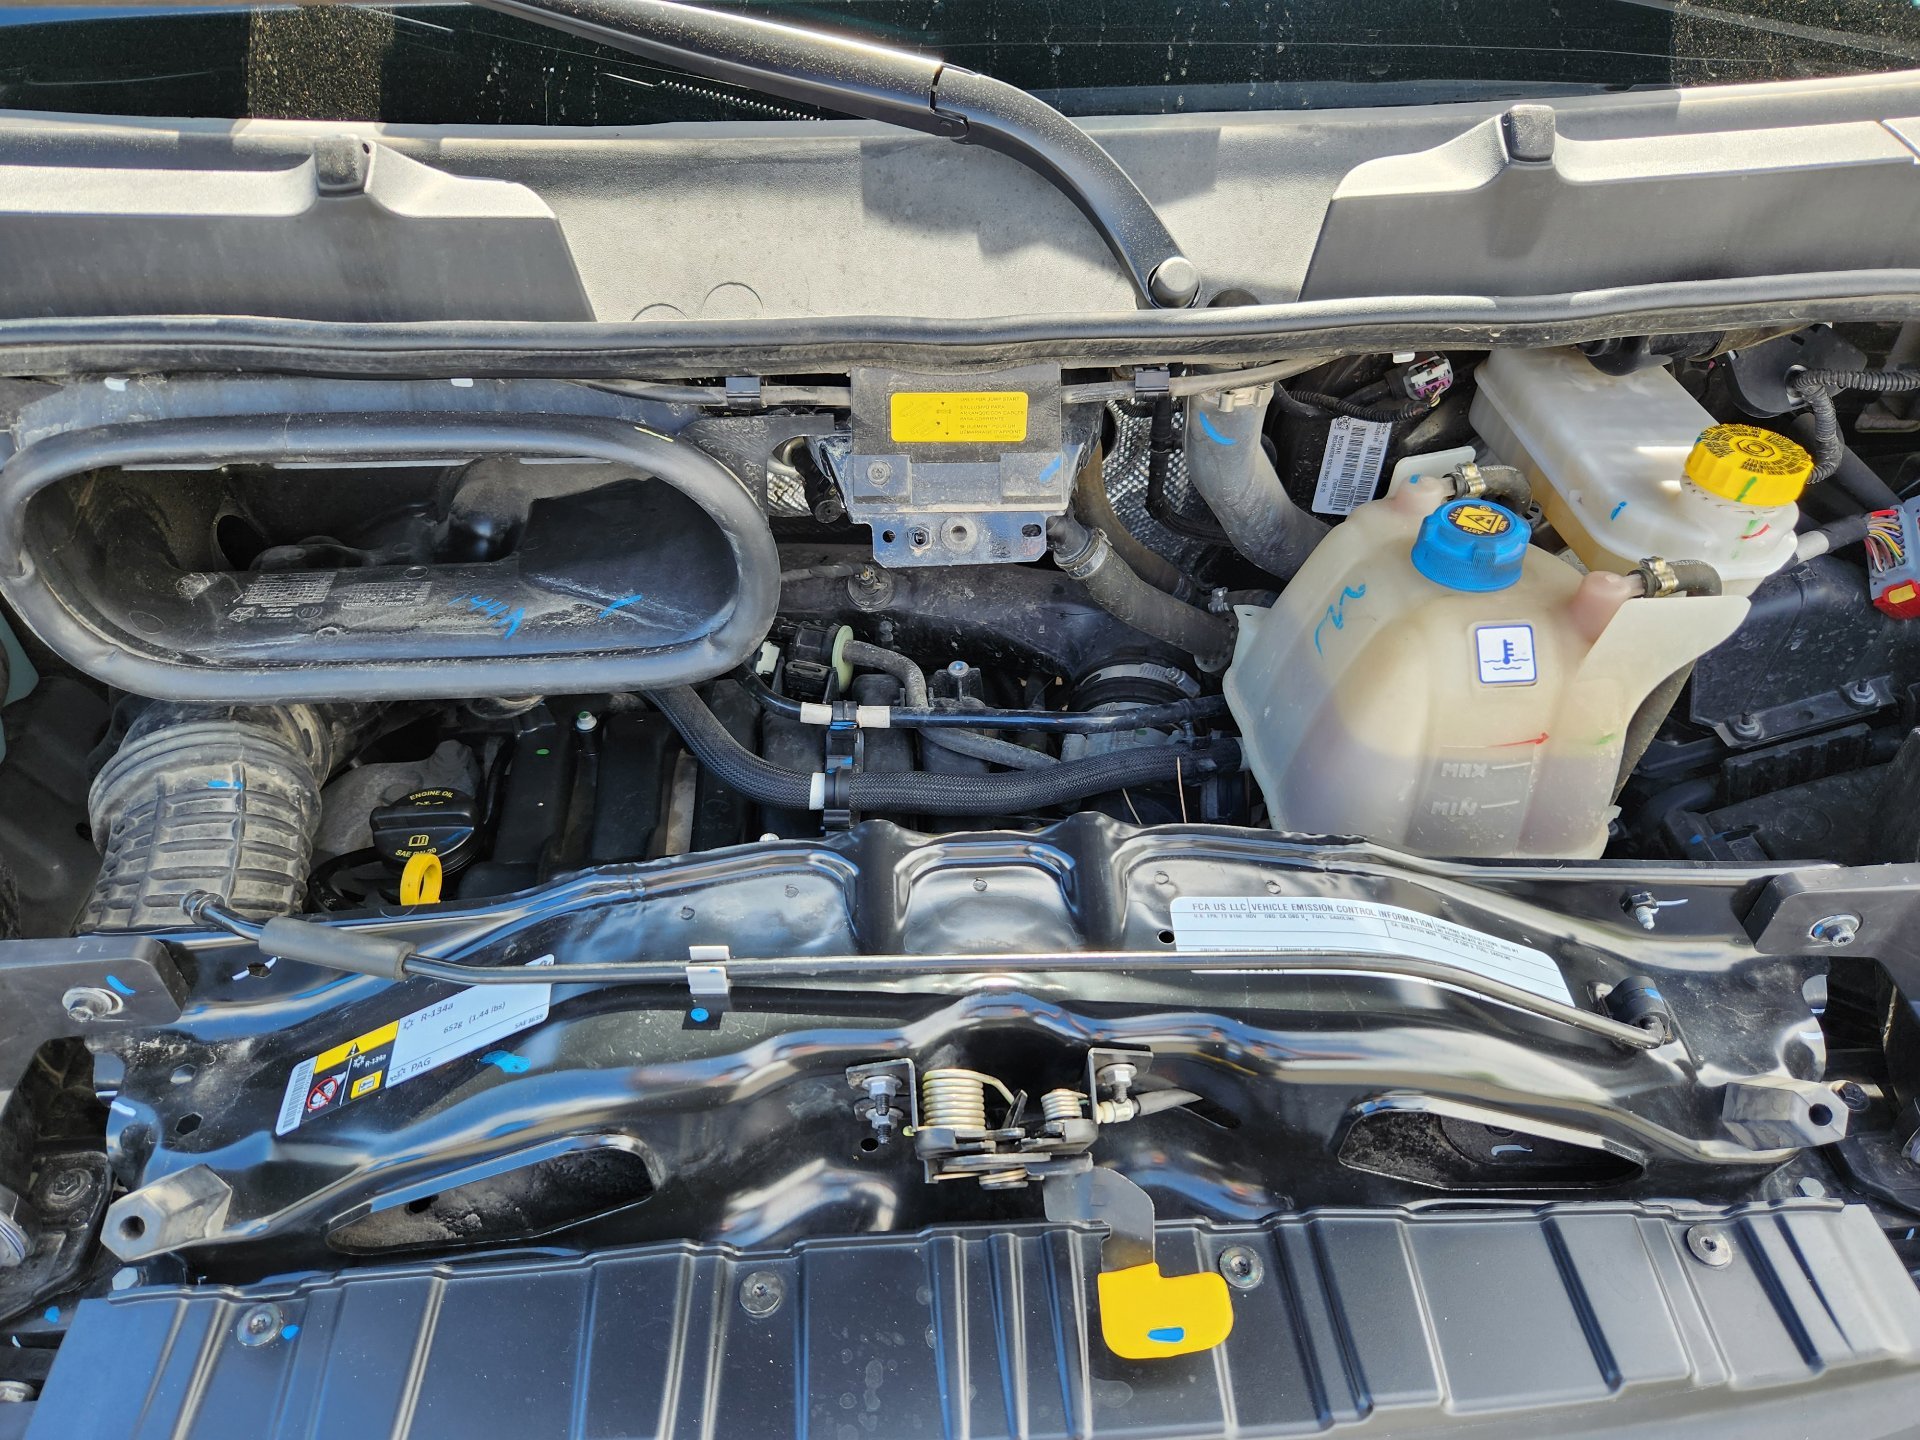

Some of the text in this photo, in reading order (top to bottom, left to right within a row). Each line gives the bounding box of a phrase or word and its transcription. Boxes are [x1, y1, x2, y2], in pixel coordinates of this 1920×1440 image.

[409, 790, 454, 800] ENGINE OIL
[1431, 800, 1478, 816] MIN
[395, 849, 412, 858] SAE
[1192, 903, 1247, 911] FCA US LLC
[1250, 903, 1434, 929] VEHICLE EMISSION CONTROL INFORMATION
[420, 1002, 454, 1022] R-134a
[443, 1001, 506, 1034] 652g (1.44 lbs)
[410, 1057, 431, 1072] PAG
